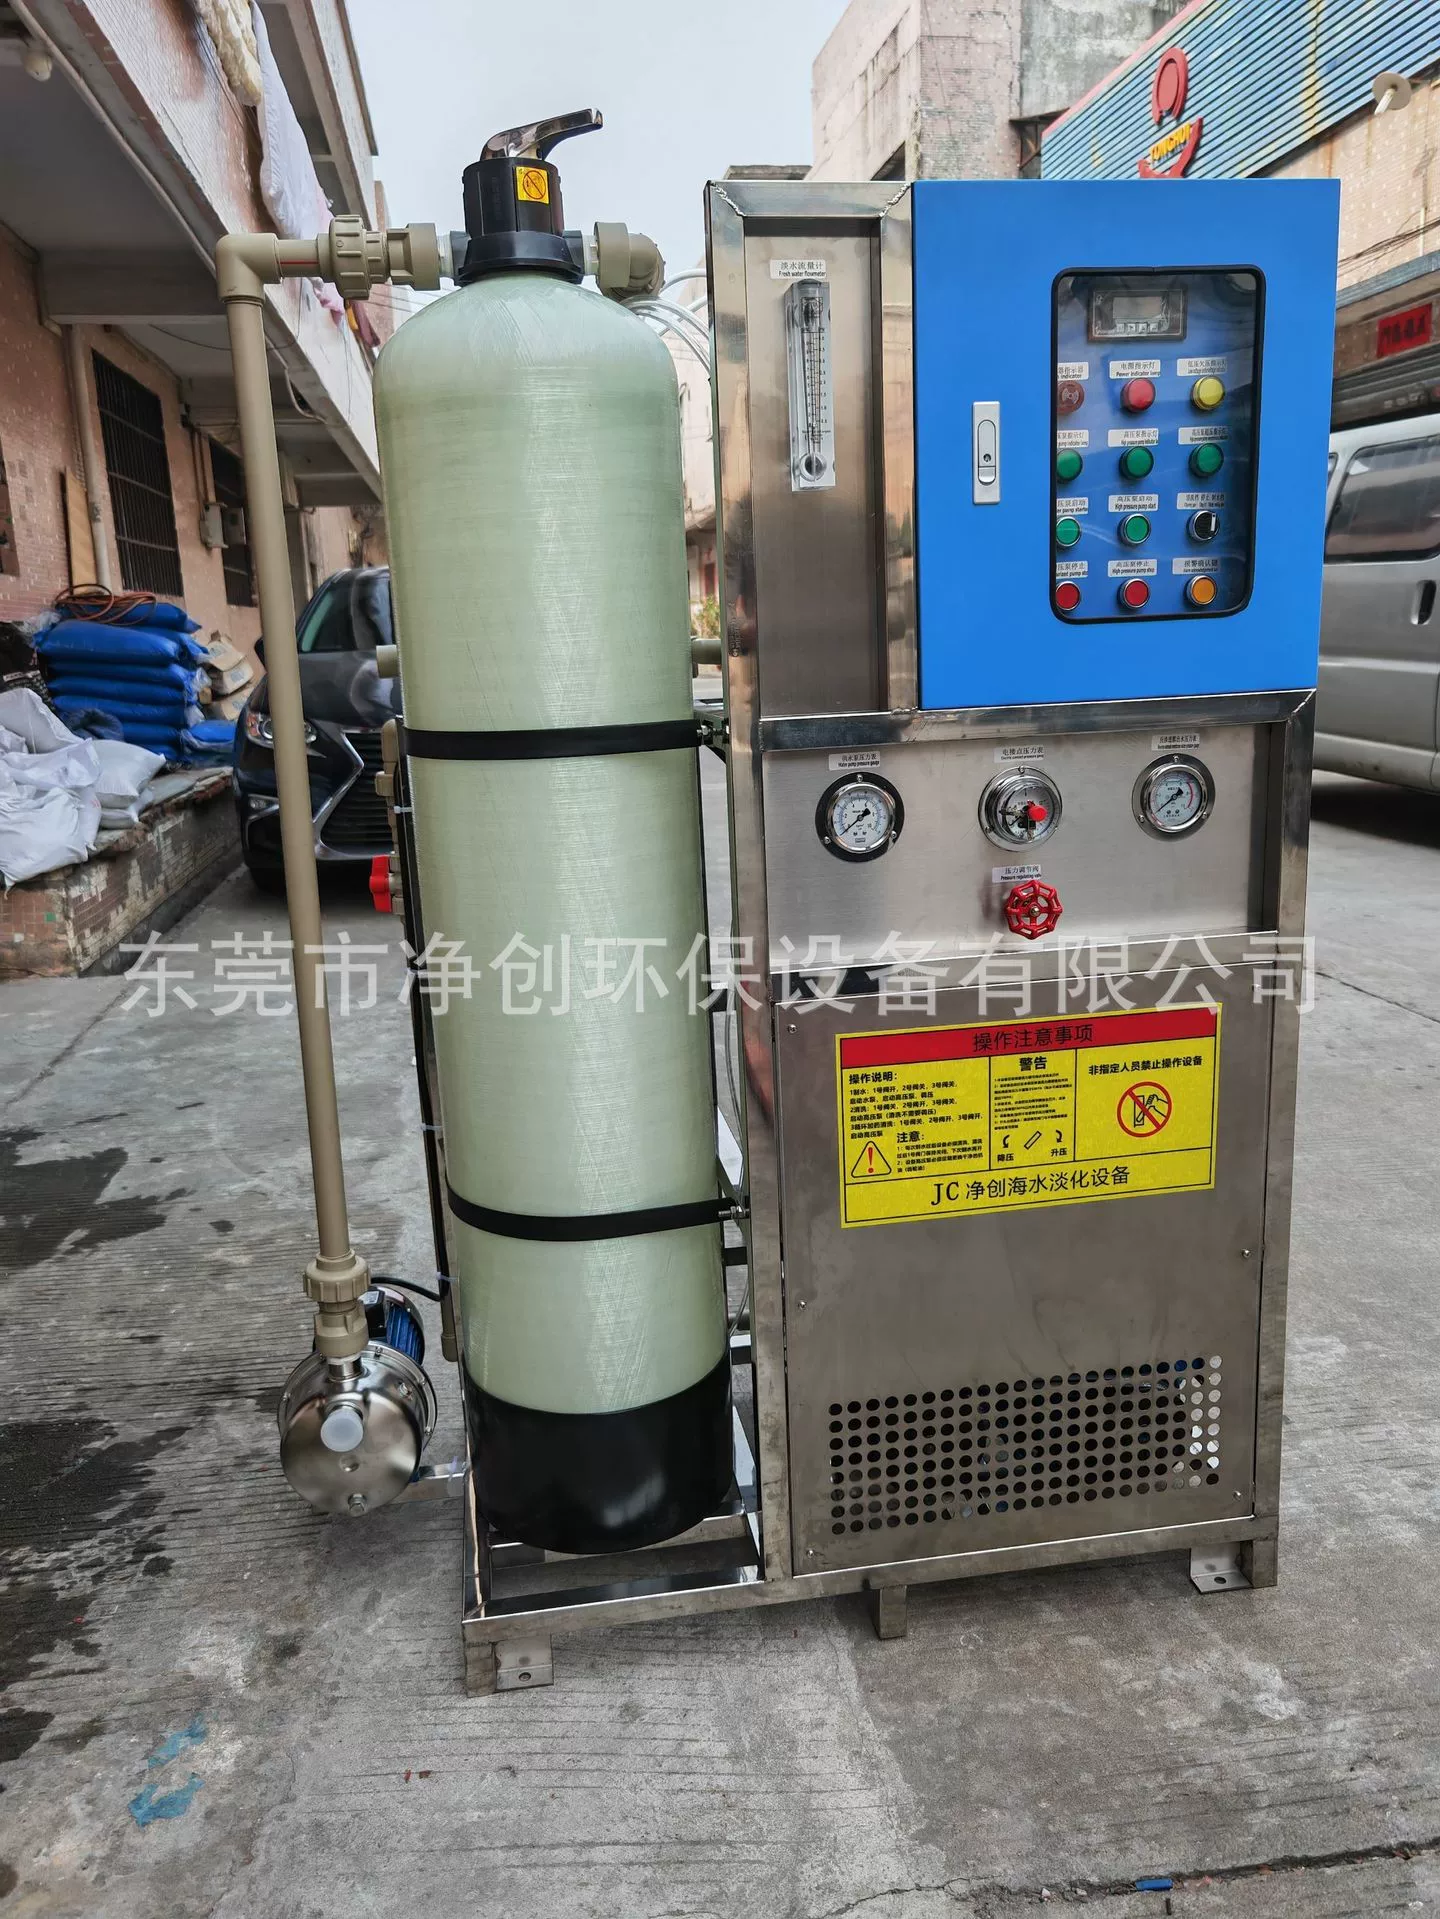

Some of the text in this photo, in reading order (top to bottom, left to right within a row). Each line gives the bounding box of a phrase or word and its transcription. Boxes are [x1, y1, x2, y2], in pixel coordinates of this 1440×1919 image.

[780, 261, 824, 270] 淡水流量计
[1120, 361, 1155, 370] 电源指示灯
[1002, 746, 1044, 755] 电接点压力表
[1005, 866, 1039, 874] 压力调节阀
[973, 1025, 1093, 1052] 操作注意事项
[1019, 1056, 1047, 1071] 警告
[1088, 1056, 1203, 1076] 非指定人员禁止操作设备
[850, 1130, 883, 1139] 启动高压泵
[1051, 1148, 1067, 1157] 升压
[997, 1153, 1014, 1163] 降压
[930, 1166, 1130, 1206] JC 净创海水淡化设备
